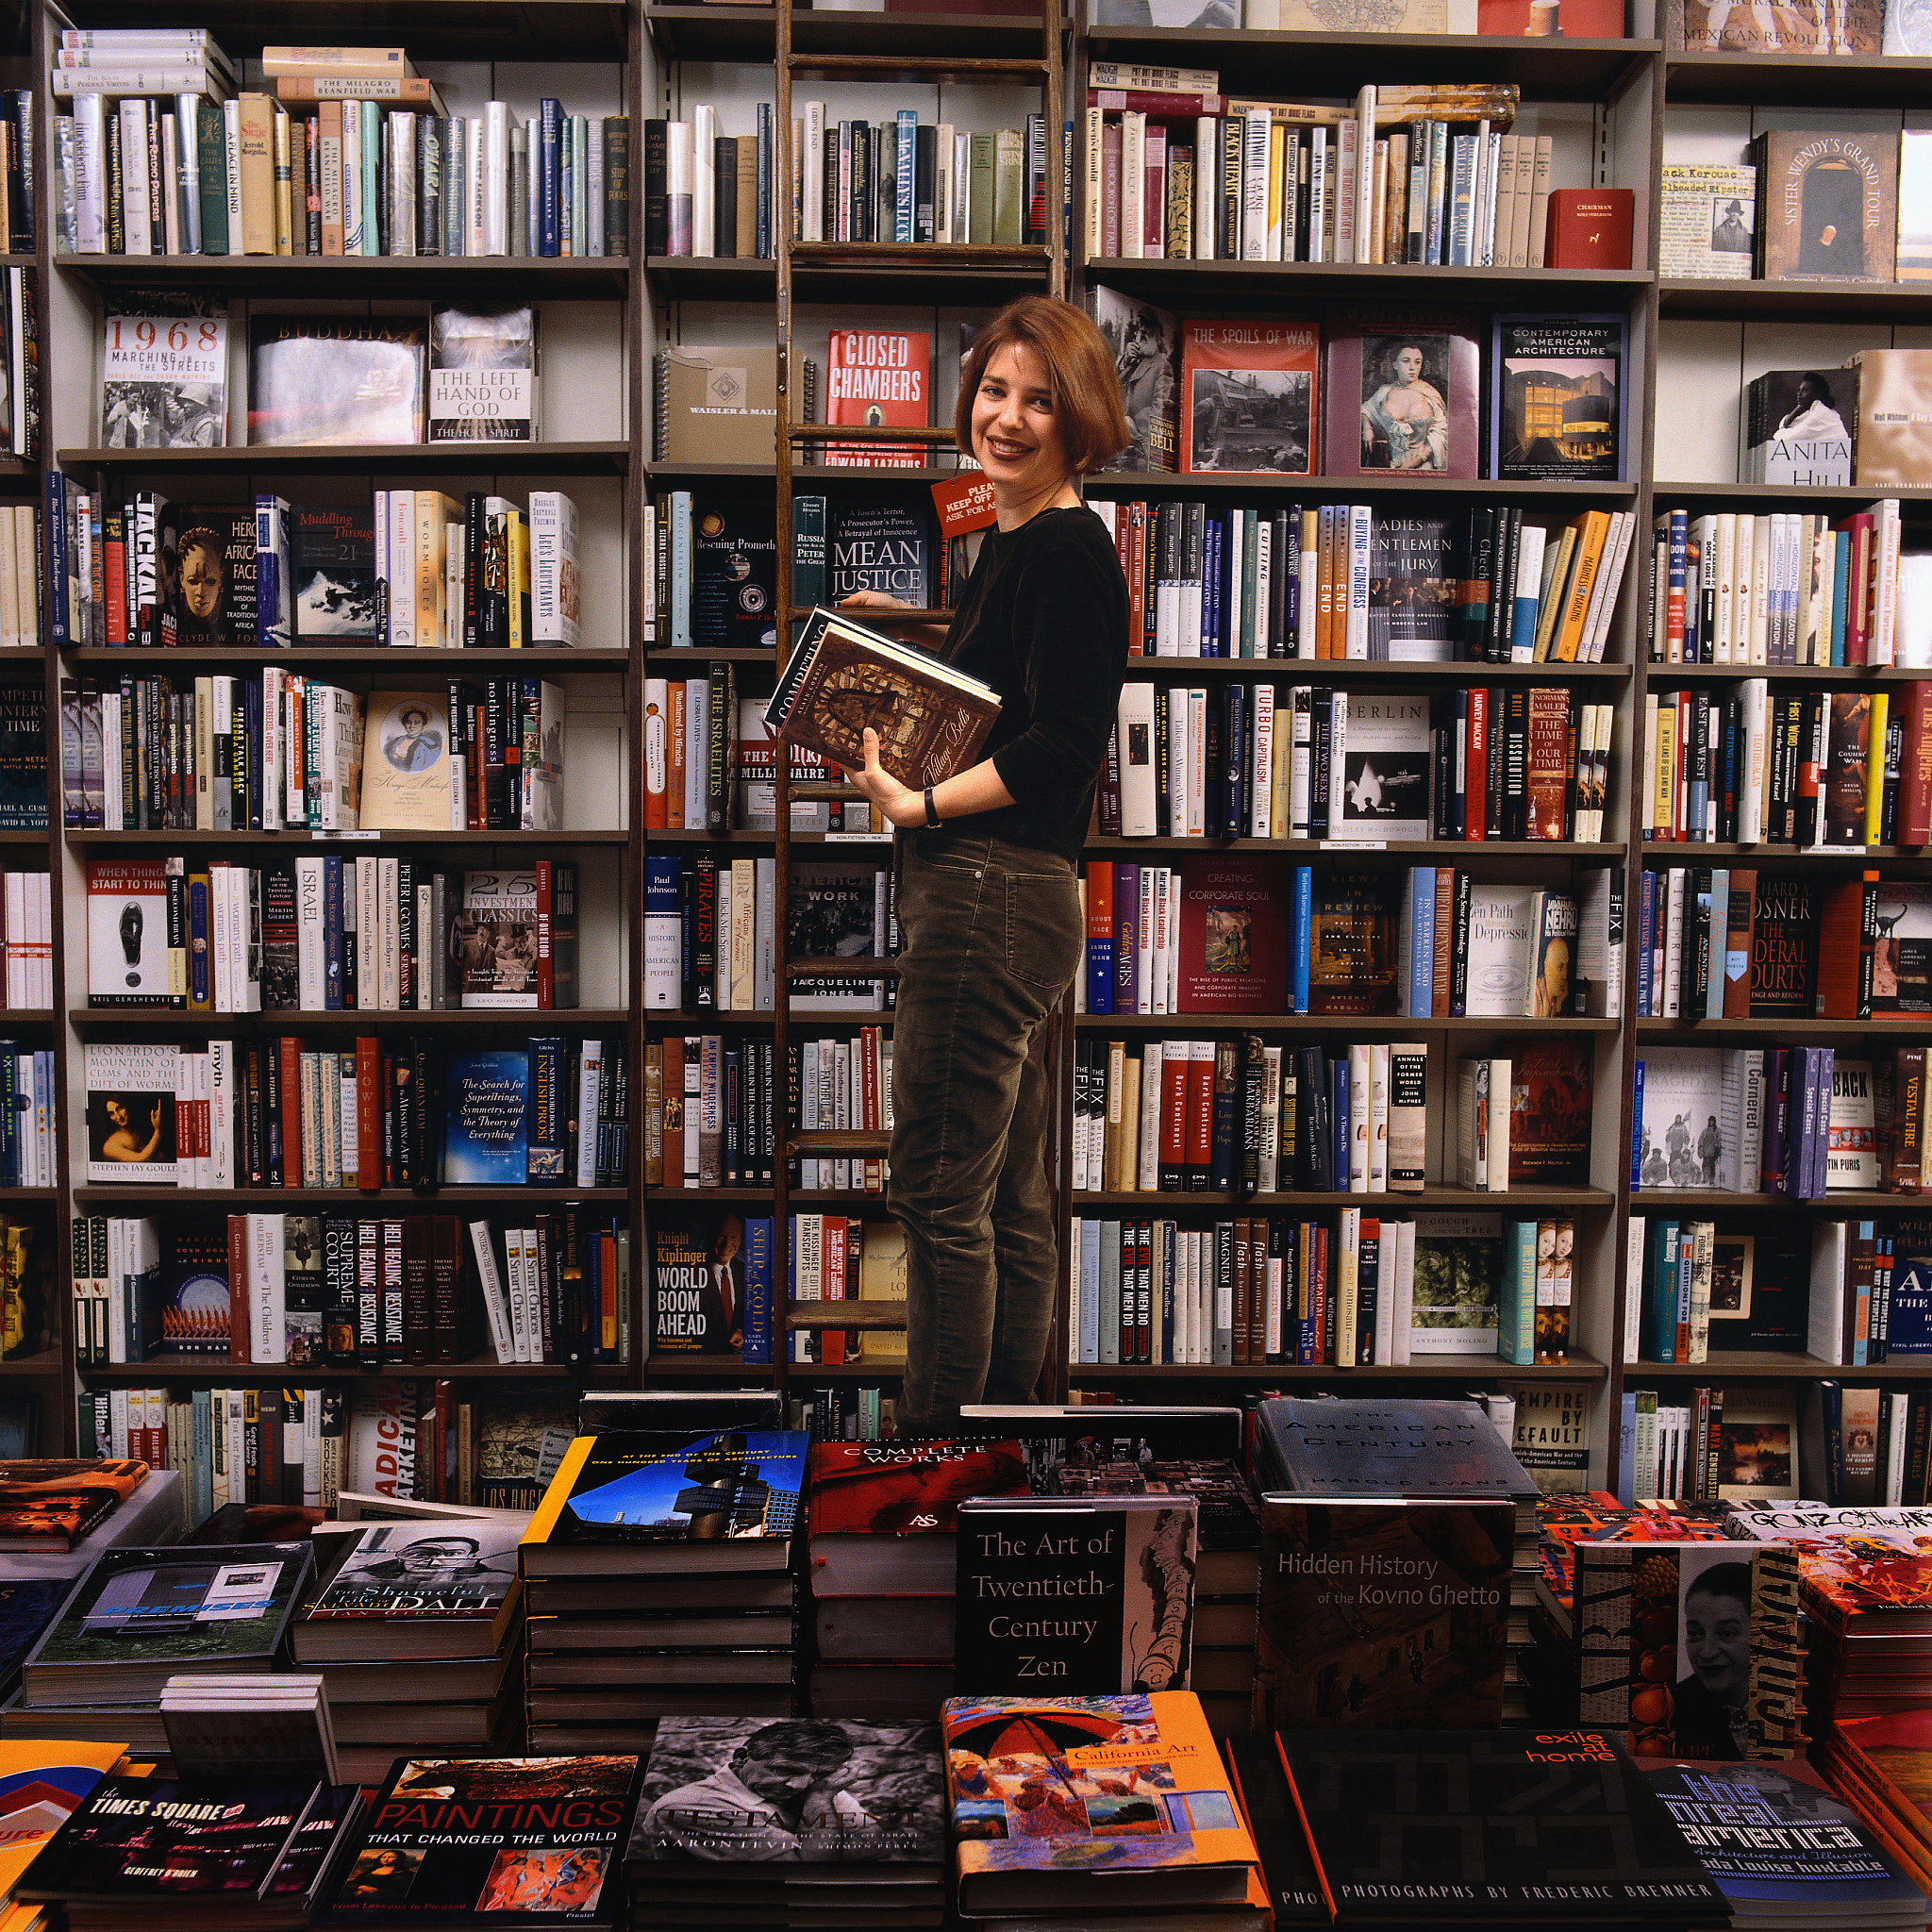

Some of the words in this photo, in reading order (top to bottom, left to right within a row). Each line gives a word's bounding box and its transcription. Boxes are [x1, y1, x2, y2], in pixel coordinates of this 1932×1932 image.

[1684, 28, 1759, 42] MEXICAN
[1764, 31, 1867, 47] REVOLUTION
[1689, 169, 1739, 180] Kerouac
[111, 321, 218, 352] 1968
[278, 324, 392, 341] BUDDHA
[1193, 327, 1215, 343] THE
[1222, 328, 1260, 344] SPOILS
[1265, 329, 1280, 344] OF
[1285, 330, 1313, 346] WAR
[1512, 328, 1609, 339] CONTEMPORARY
[1530, 338, 1591, 346] AMERICAN
[111, 351, 176, 364] MARCHING
[845, 334, 908, 367] CLOSED
[1513, 346, 1606, 356] ARCHITECTURE
[140, 363, 156, 372] THE
[162, 359, 216, 373] STREETS
[440, 372, 472, 386] THE
[480, 372, 519, 386] LEFT
[830, 368, 922, 402] CHAMBERS
[437, 387, 491, 402] HAND
[499, 387, 522, 401] OF
[458, 402, 500, 417] GOD
[436, 428, 456, 438] THE
[458, 428, 487, 438] HOLY
[490, 427, 521, 439] SPIRIT
[1150, 434, 1174, 453] BELL
[1770, 440, 1848, 461] ANITA
[946, 497, 973, 513] KEEP
[974, 491, 992, 506] OFF
[300, 511, 353, 527] Muddling
[945, 511, 963, 523] ASK
[967, 505, 986, 517] FOR
[847, 518, 887, 527] Prosecutor's
[891, 518, 915, 526] Power,
[797, 533, 824, 543] RUSSIA
[844, 529, 872, 538] Betrayal
[136, 492, 157, 611] JACKAL
[697, 539, 736, 552] Rescuing
[797, 549, 824, 558] PETER
[833, 541, 923, 567] MEAN
[233, 563, 258, 580] FACE
[832, 569, 923, 595] JUSTICE
[1342, 704, 1422, 720] BERLIN
[1534, 702, 1566, 710] MAILER
[486, 681, 496, 763] nothingness
[1538, 720, 1561, 730] THE
[1535, 730, 1563, 740] TIME
[1537, 749, 1561, 758] OUR
[1507, 734, 1523, 796] DISSOLUTION
[1534, 758, 1561, 768] TIME
[97, 868, 122, 877] WHEN
[653, 875, 671, 885] Paul
[1207, 874, 1253, 883] CREATING
[92, 879, 122, 890] START
[125, 879, 140, 889] TO
[471, 874, 538, 895] 25
[647, 885, 677, 895] Johnson
[303, 869, 316, 925] ISRAEL
[470, 897, 537, 908] INVESTMENT
[808, 891, 859, 901] WORK
[1189, 890, 1243, 901] CORPORATE
[1246, 891, 1271, 901] SOUL
[698, 871, 712, 943] PIRATES
[469, 909, 537, 923] CLASSICS
[1609, 902, 1622, 931] FIX
[213, 1045, 223, 1089] myth
[462, 1078, 478, 1089] The
[480, 1079, 508, 1090] Search
[510, 1078, 525, 1091] for
[360, 1060, 373, 1133] POWER
[464, 1091, 522, 1104] Superstrings,
[459, 1105, 505, 1116] Symmetry,
[508, 1105, 525, 1114] and
[463, 1117, 475, 1126] the
[477, 1116, 507, 1128] Theory
[509, 1115, 519, 1128] of
[468, 1129, 515, 1141] Everything
[657, 1231, 689, 1245] Knight
[325, 1231, 339, 1290] COURT
[657, 1248, 708, 1264] Kiplinger
[657, 1267, 708, 1290] WORLD
[658, 1291, 701, 1312] BOOM
[658, 1313, 708, 1336] AHEAD
[1518, 1391, 1583, 1408] EMPIRE
[1562, 1410, 1582, 1425] BY
[1285, 1420, 1476, 1432] AMERICAN
[842, 1444, 987, 1456] COMPLETE
[1291, 1437, 1477, 1448] CENTURY
[867, 1454, 965, 1463] WORKS
[976, 1533, 1028, 1558] The
[1036, 1533, 1077, 1557] Art
[1087, 1529, 1115, 1557] of
[1277, 1552, 1353, 1575] Hidden
[1359, 1553, 1440, 1580] History
[972, 1574, 1115, 1598] Twentieth-
[1318, 1591, 1331, 1604] of
[1334, 1591, 1355, 1604] the
[1358, 1584, 1423, 1606] Kovno
[1428, 1584, 1500, 1606] Ghetto
[102, 1599, 275, 1617] PREMISES
[989, 1615, 1098, 1644] Century
[1017, 1655, 1068, 1677] Zen
[1535, 1731, 1606, 1744] exile
[1074, 1745, 1161, 1761] California
[1167, 1741, 1196, 1756] Art
[1582, 1740, 1612, 1753] at
[1525, 1750, 1617, 1762] home
[89, 1798, 151, 1816] TIMES
[150, 1802, 226, 1822] SQUARE
[375, 1801, 625, 1831] PAINTINGS
[656, 1810, 927, 1829] TESTAMENT
[366, 1833, 415, 1844] THAT
[418, 1833, 506, 1845] CHANGED
[511, 1833, 547, 1845] THE
[552, 1831, 618, 1844] WORLD
[1675, 1823, 1864, 1849] america
[657, 1839, 730, 1850] AARON
[740, 1839, 803, 1850] LEVIN
[1799, 1859, 1885, 1872] huxtable
[1341, 1884, 1476, 1899] PHOTOGRAPHS
[1487, 1886, 1508, 1898] BY
[1521, 1885, 1614, 1899] FREDERIC
[1624, 1883, 1713, 1900] BRENNER
